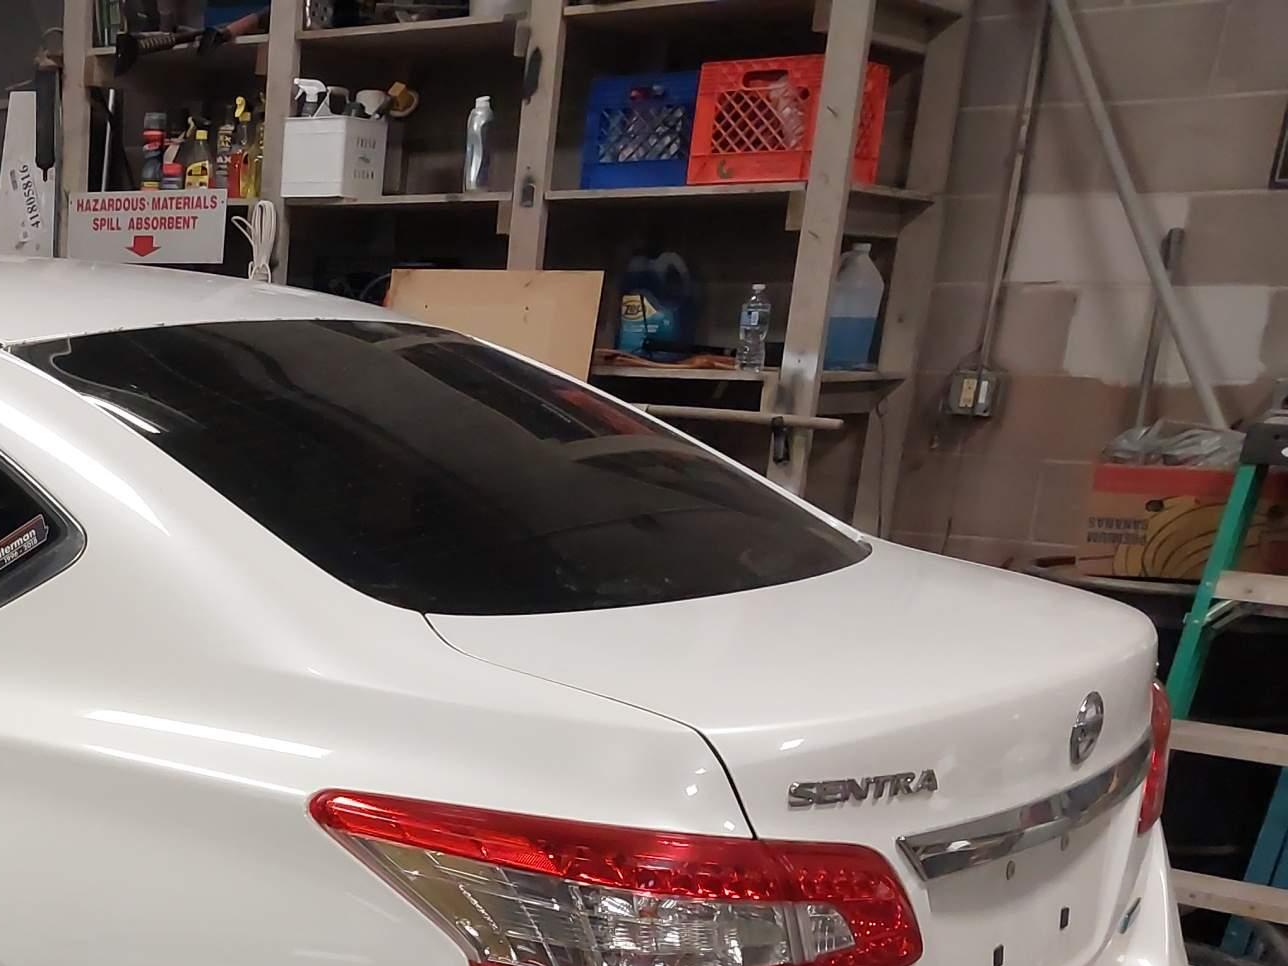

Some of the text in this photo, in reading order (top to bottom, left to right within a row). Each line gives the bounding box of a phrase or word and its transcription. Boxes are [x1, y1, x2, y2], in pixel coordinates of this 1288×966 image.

[18, 163, 41, 229] 41805816
[76, 195, 218, 212] HAZARDOUS MATERIALS
[92, 216, 198, 231] SPILL ABSORBENT
[788, 769, 938, 808] SENTRA
